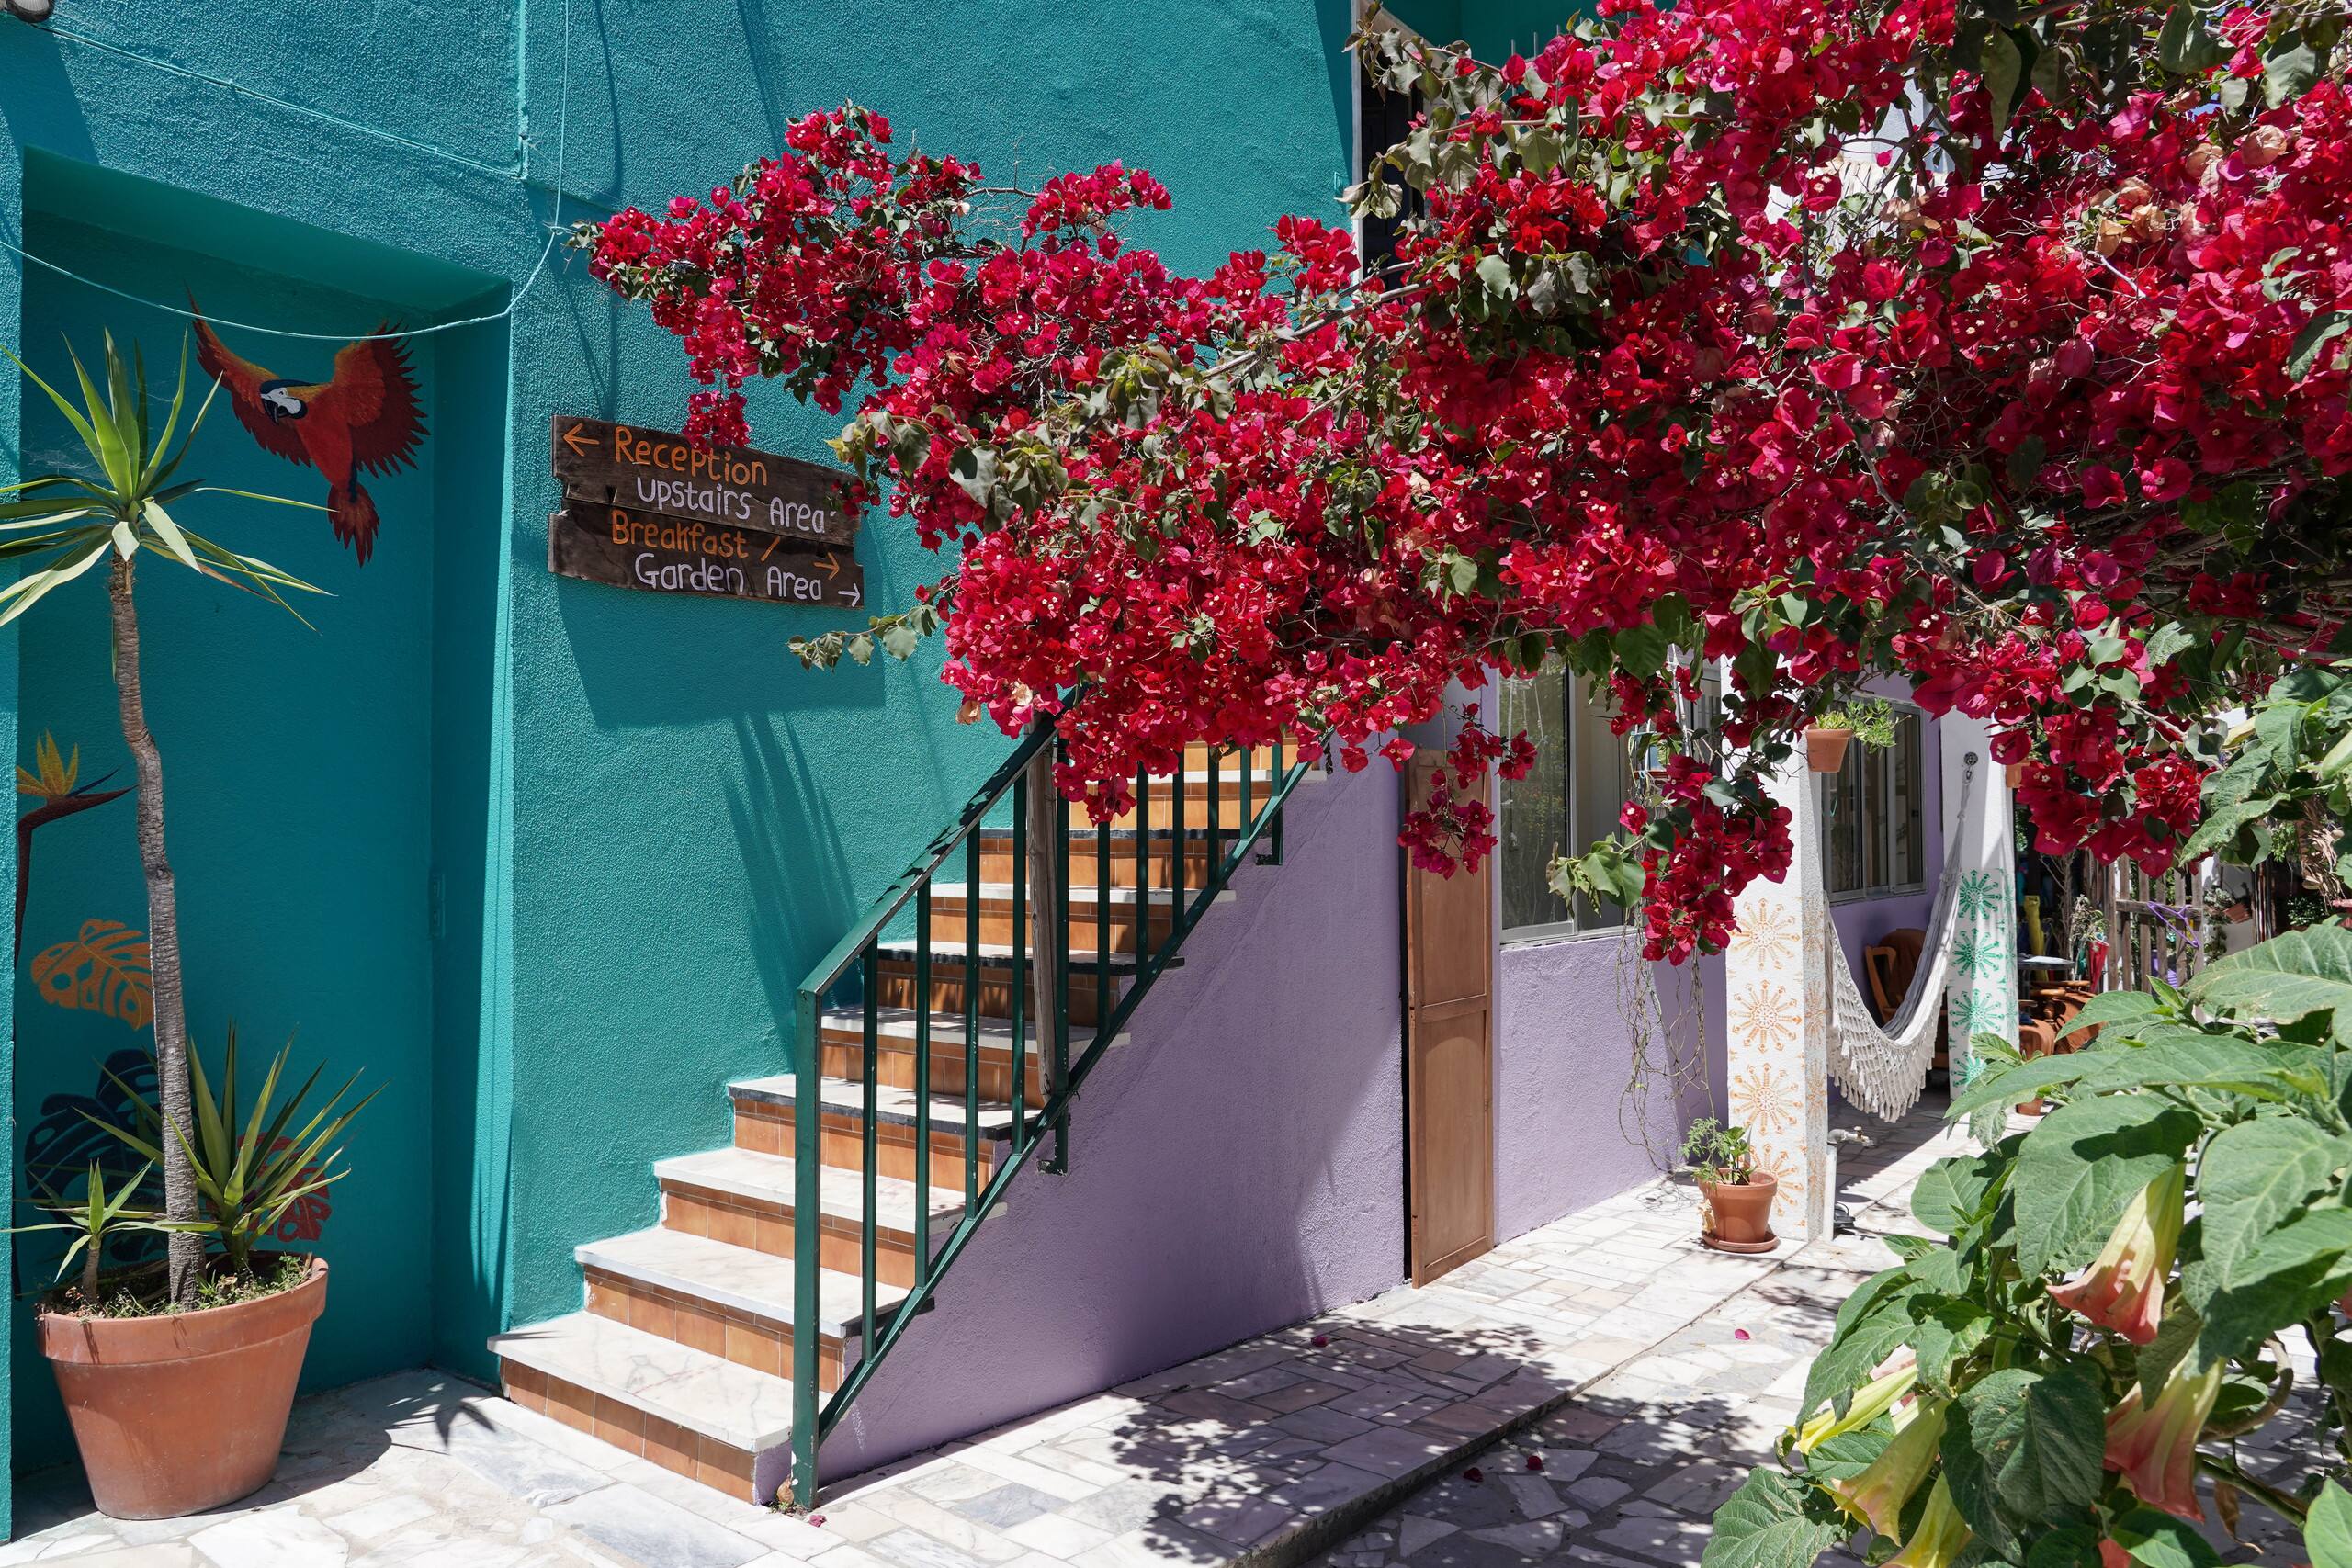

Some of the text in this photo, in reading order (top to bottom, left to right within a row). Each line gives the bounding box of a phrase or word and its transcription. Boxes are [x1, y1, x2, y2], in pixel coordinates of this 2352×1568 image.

[615, 426, 768, 486] Reception
[637, 477, 826, 534] Upstairs Area
[611, 509, 749, 558] Breakfast
[635, 553, 822, 600] Garden Area
